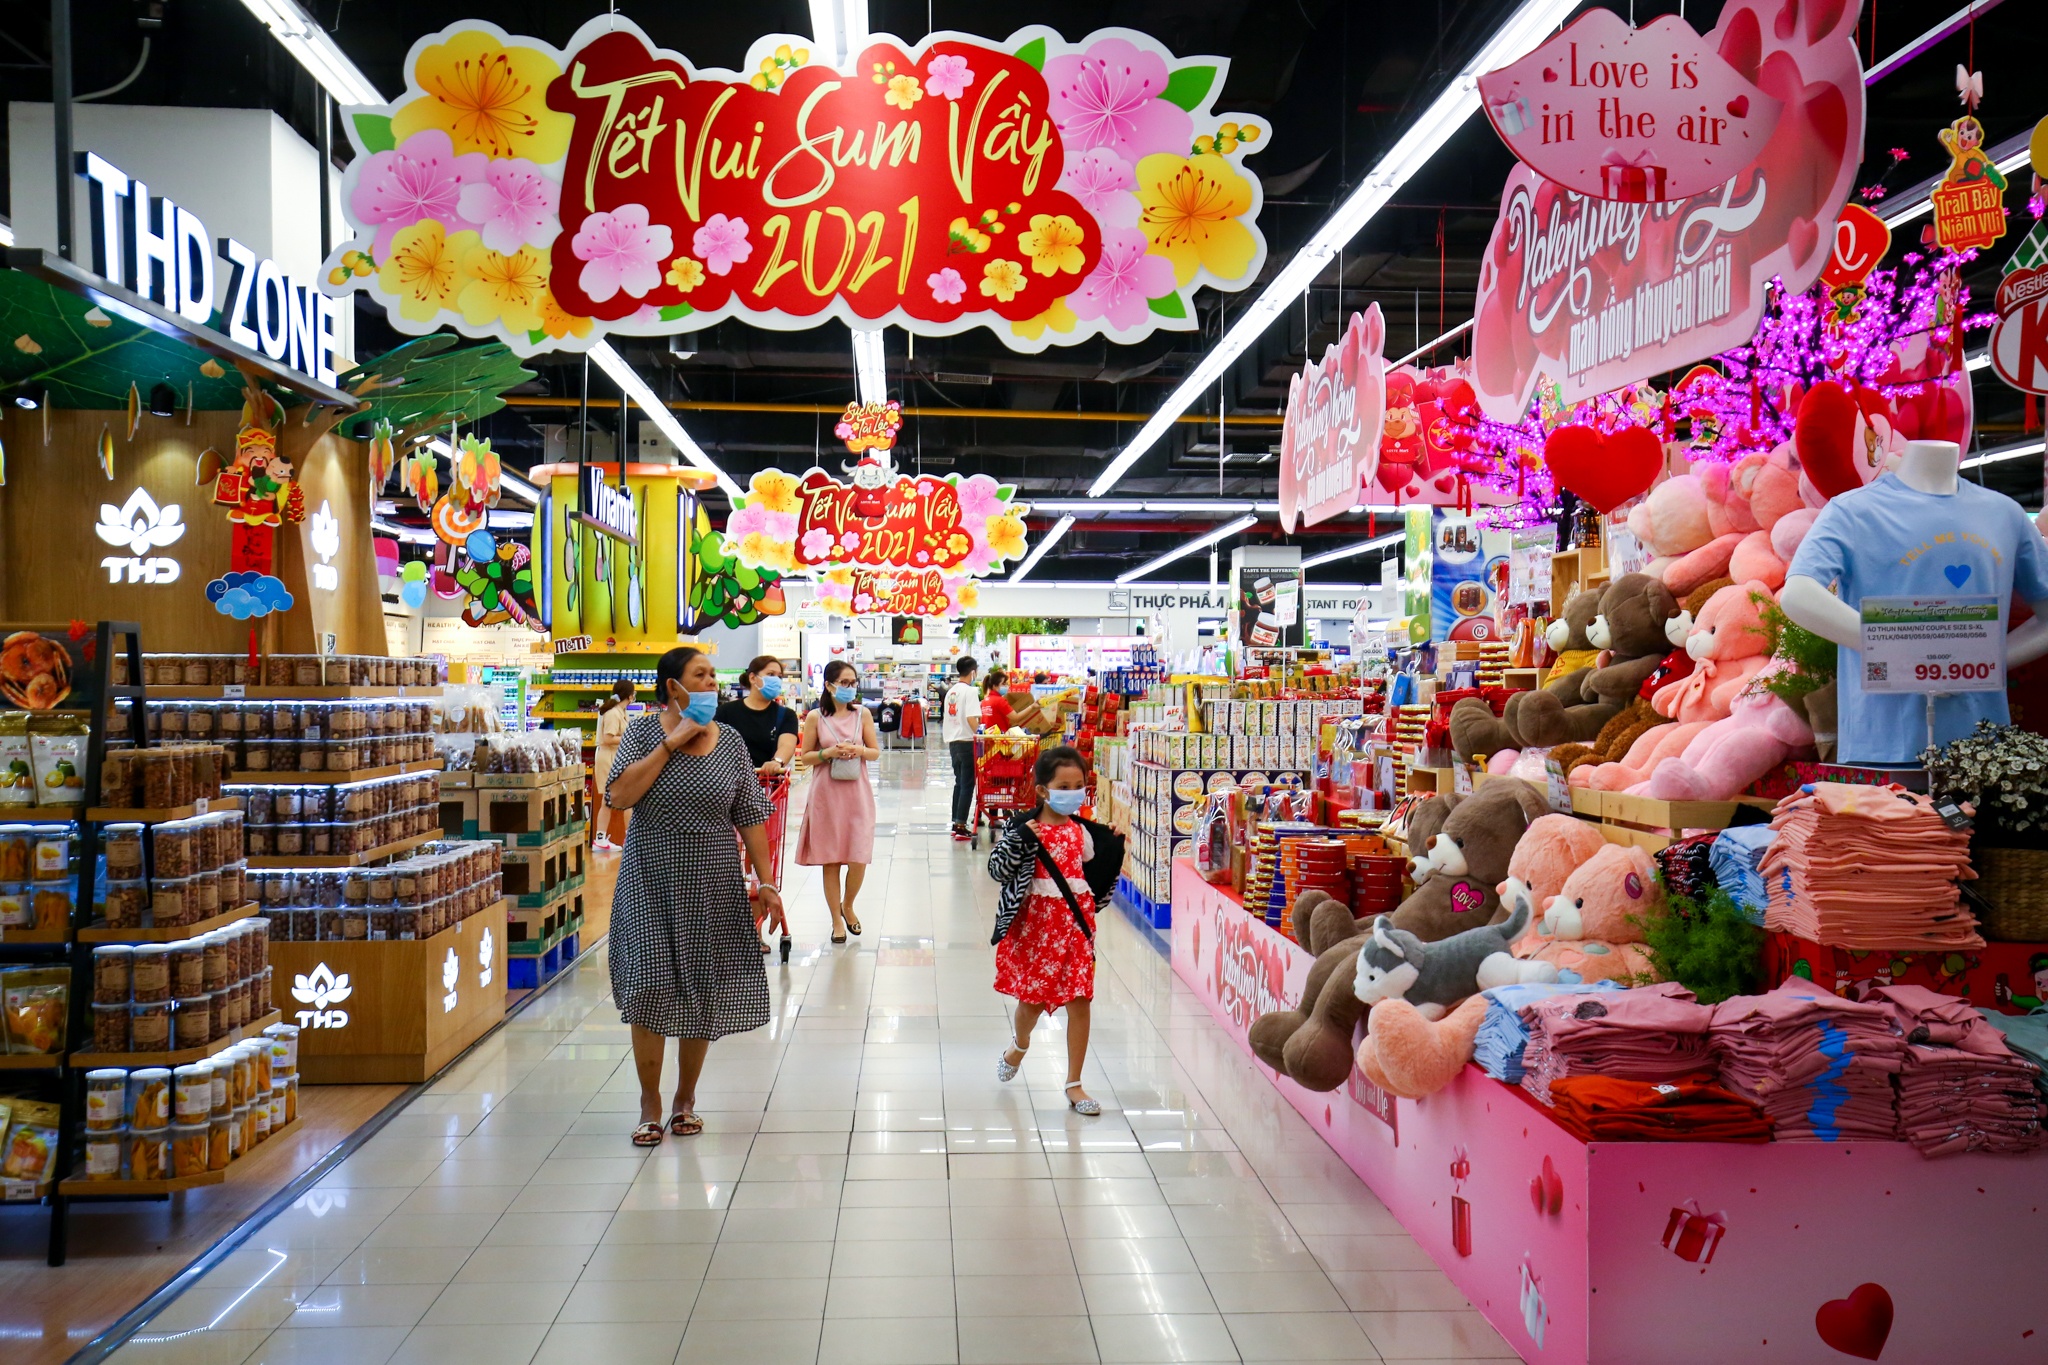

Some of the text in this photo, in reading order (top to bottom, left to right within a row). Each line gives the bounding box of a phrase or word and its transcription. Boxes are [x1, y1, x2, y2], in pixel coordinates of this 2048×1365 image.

[1569, 42, 1699, 89] Love is
[1541, 97, 1727, 146] in the air
[570, 61, 1053, 222] Tết Vui Sum Vầy
[1937, 187, 1999, 217] Tràn Đầy
[1940, 215, 1977, 241] Niềm
[752, 196, 920, 297] 2021
[82, 151, 339, 389] THD ZONE
[1569, 244, 1732, 383] mặn nồng khuyến mãi
[590, 466, 637, 540] Vinamit
[803, 482, 841, 531] Tết
[924, 487, 959, 531] Vầy
[859, 527, 915, 560] 2021
[1899, 541, 1933, 566] TELL
[1934, 531, 1956, 544] ME
[1961, 532, 1989, 549] YOU
[100, 557, 181, 584] THD
[886, 593, 918, 612] 2021
[1133, 594, 1175, 611] THỰC
[1132, 724, 1146, 732] AFC
[1166, 707, 1180, 716] AFC
[1452, 888, 1478, 910] LOVE
[295, 1010, 349, 1029] THD
